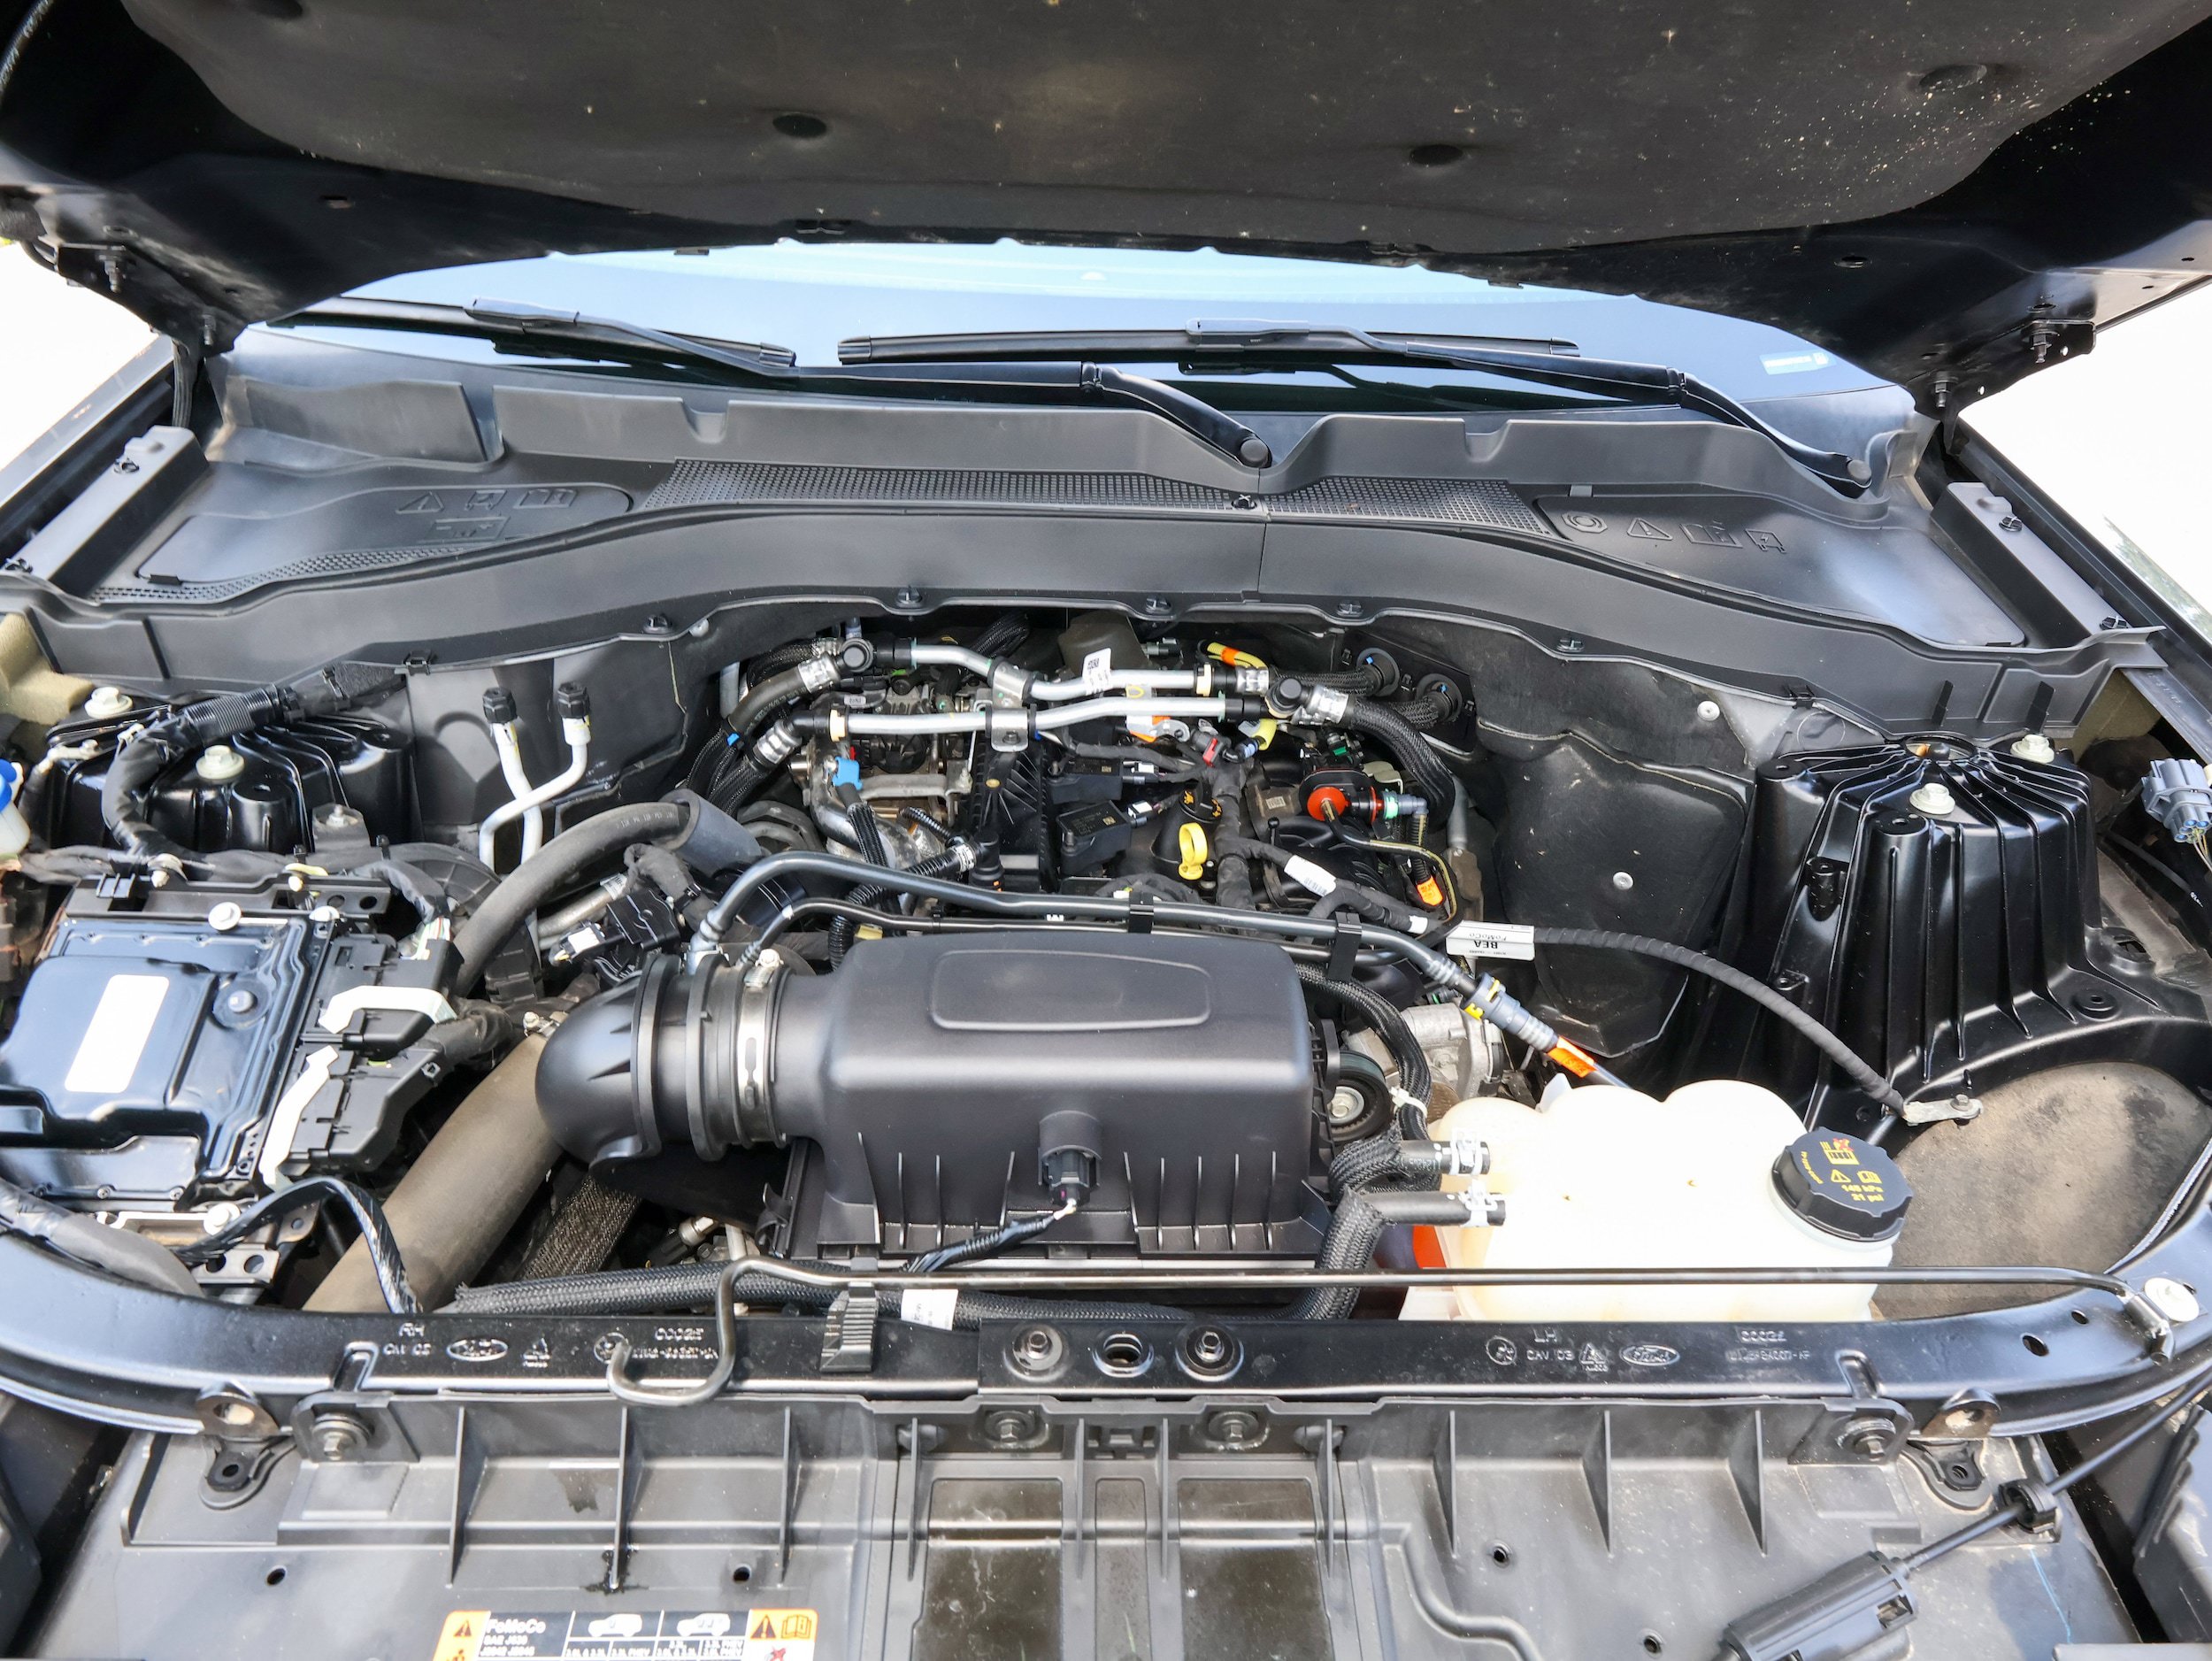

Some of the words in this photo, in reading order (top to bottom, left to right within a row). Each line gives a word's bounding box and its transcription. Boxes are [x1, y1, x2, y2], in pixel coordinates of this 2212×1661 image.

[1473, 940, 1498, 950] BEA
[1532, 1328, 1557, 1342] LH
[486, 1619, 546, 1634] FoMoCo
